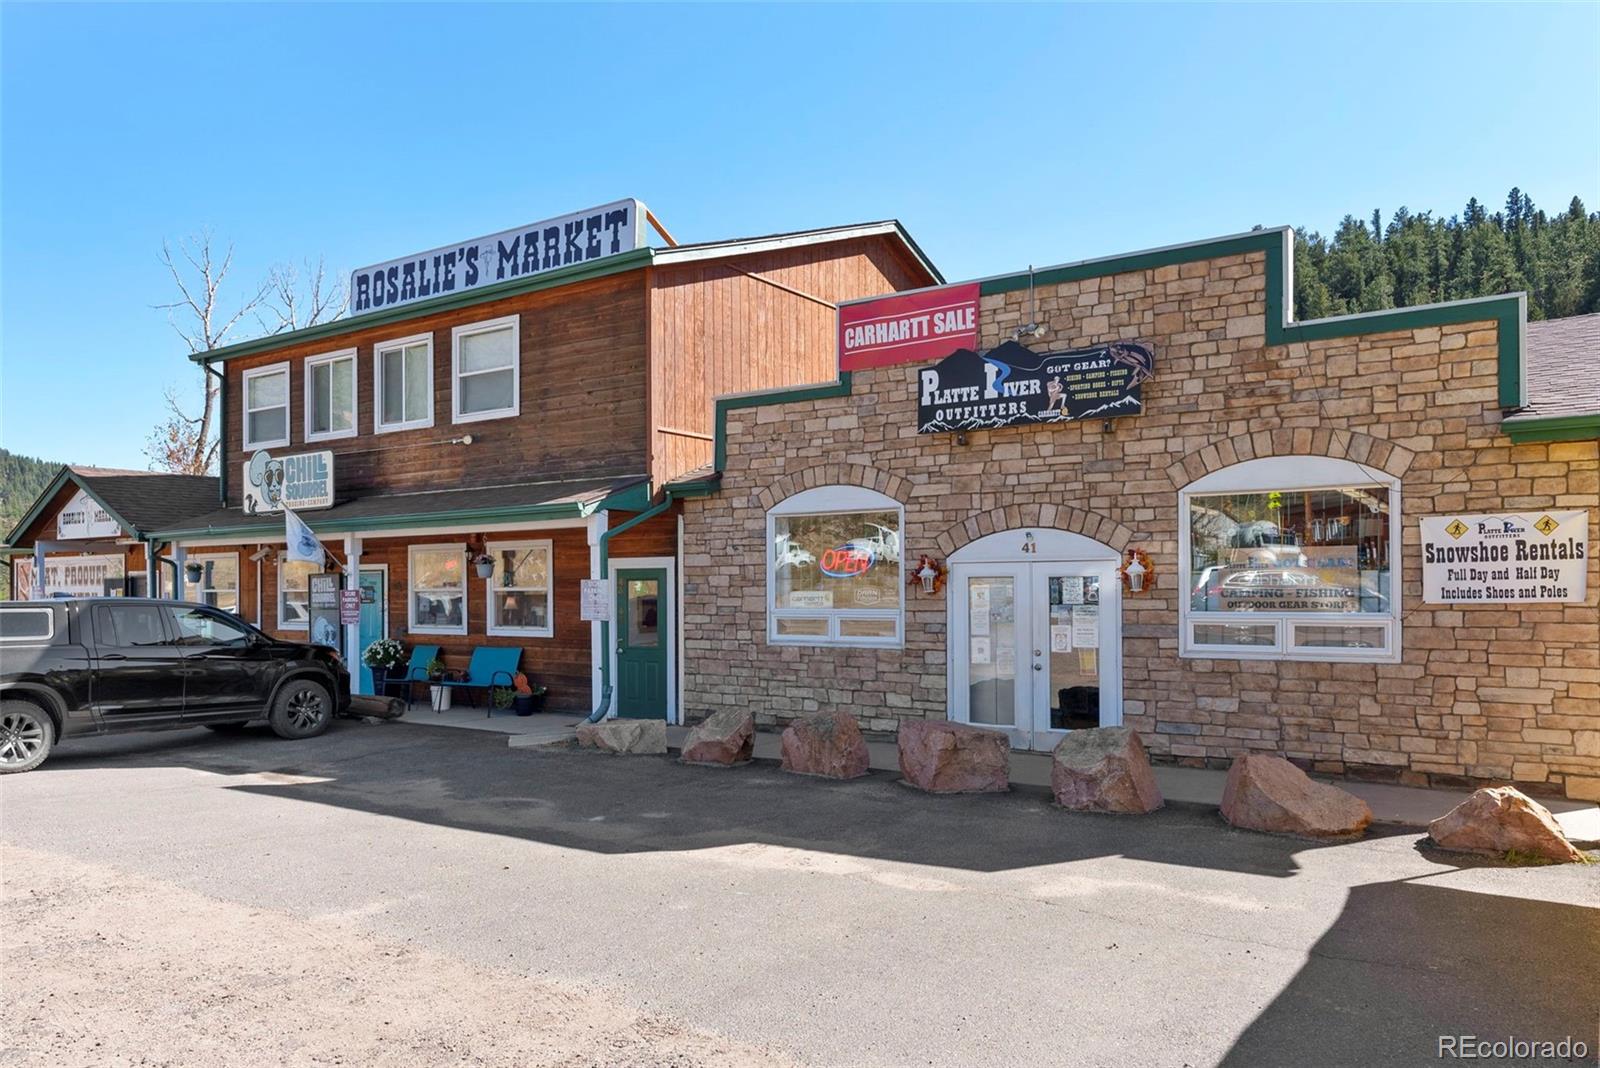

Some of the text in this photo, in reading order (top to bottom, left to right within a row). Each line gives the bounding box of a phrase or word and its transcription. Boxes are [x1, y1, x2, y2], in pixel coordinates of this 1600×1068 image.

[356, 208, 628, 311] ROSALIE'S MARKET
[844, 307, 975, 349] CARHARTT SALE
[1047, 359, 1111, 374] GOT GEAR?
[1086, 371, 1105, 379] CAMPING
[1110, 368, 1128, 377] FISHING
[921, 360, 1041, 406] PLATTE RIVER
[1099, 389, 1119, 397] RENTALS
[935, 401, 1027, 421] OUTFITTERS
[286, 480, 328, 500] SQUIRREL
[1478, 523, 1501, 534] PLATTE
[1021, 542, 1037, 553] 41
[1425, 537, 1584, 564] Snowshoe Rentals
[822, 548, 870, 574] OPEN
[1447, 566, 1560, 583] Full Day and Half Day
[1296, 588, 1355, 598] FISHING
[1441, 585, 1568, 599] Includes Shoes and Poles
[1279, 600, 1308, 609] GEAR
